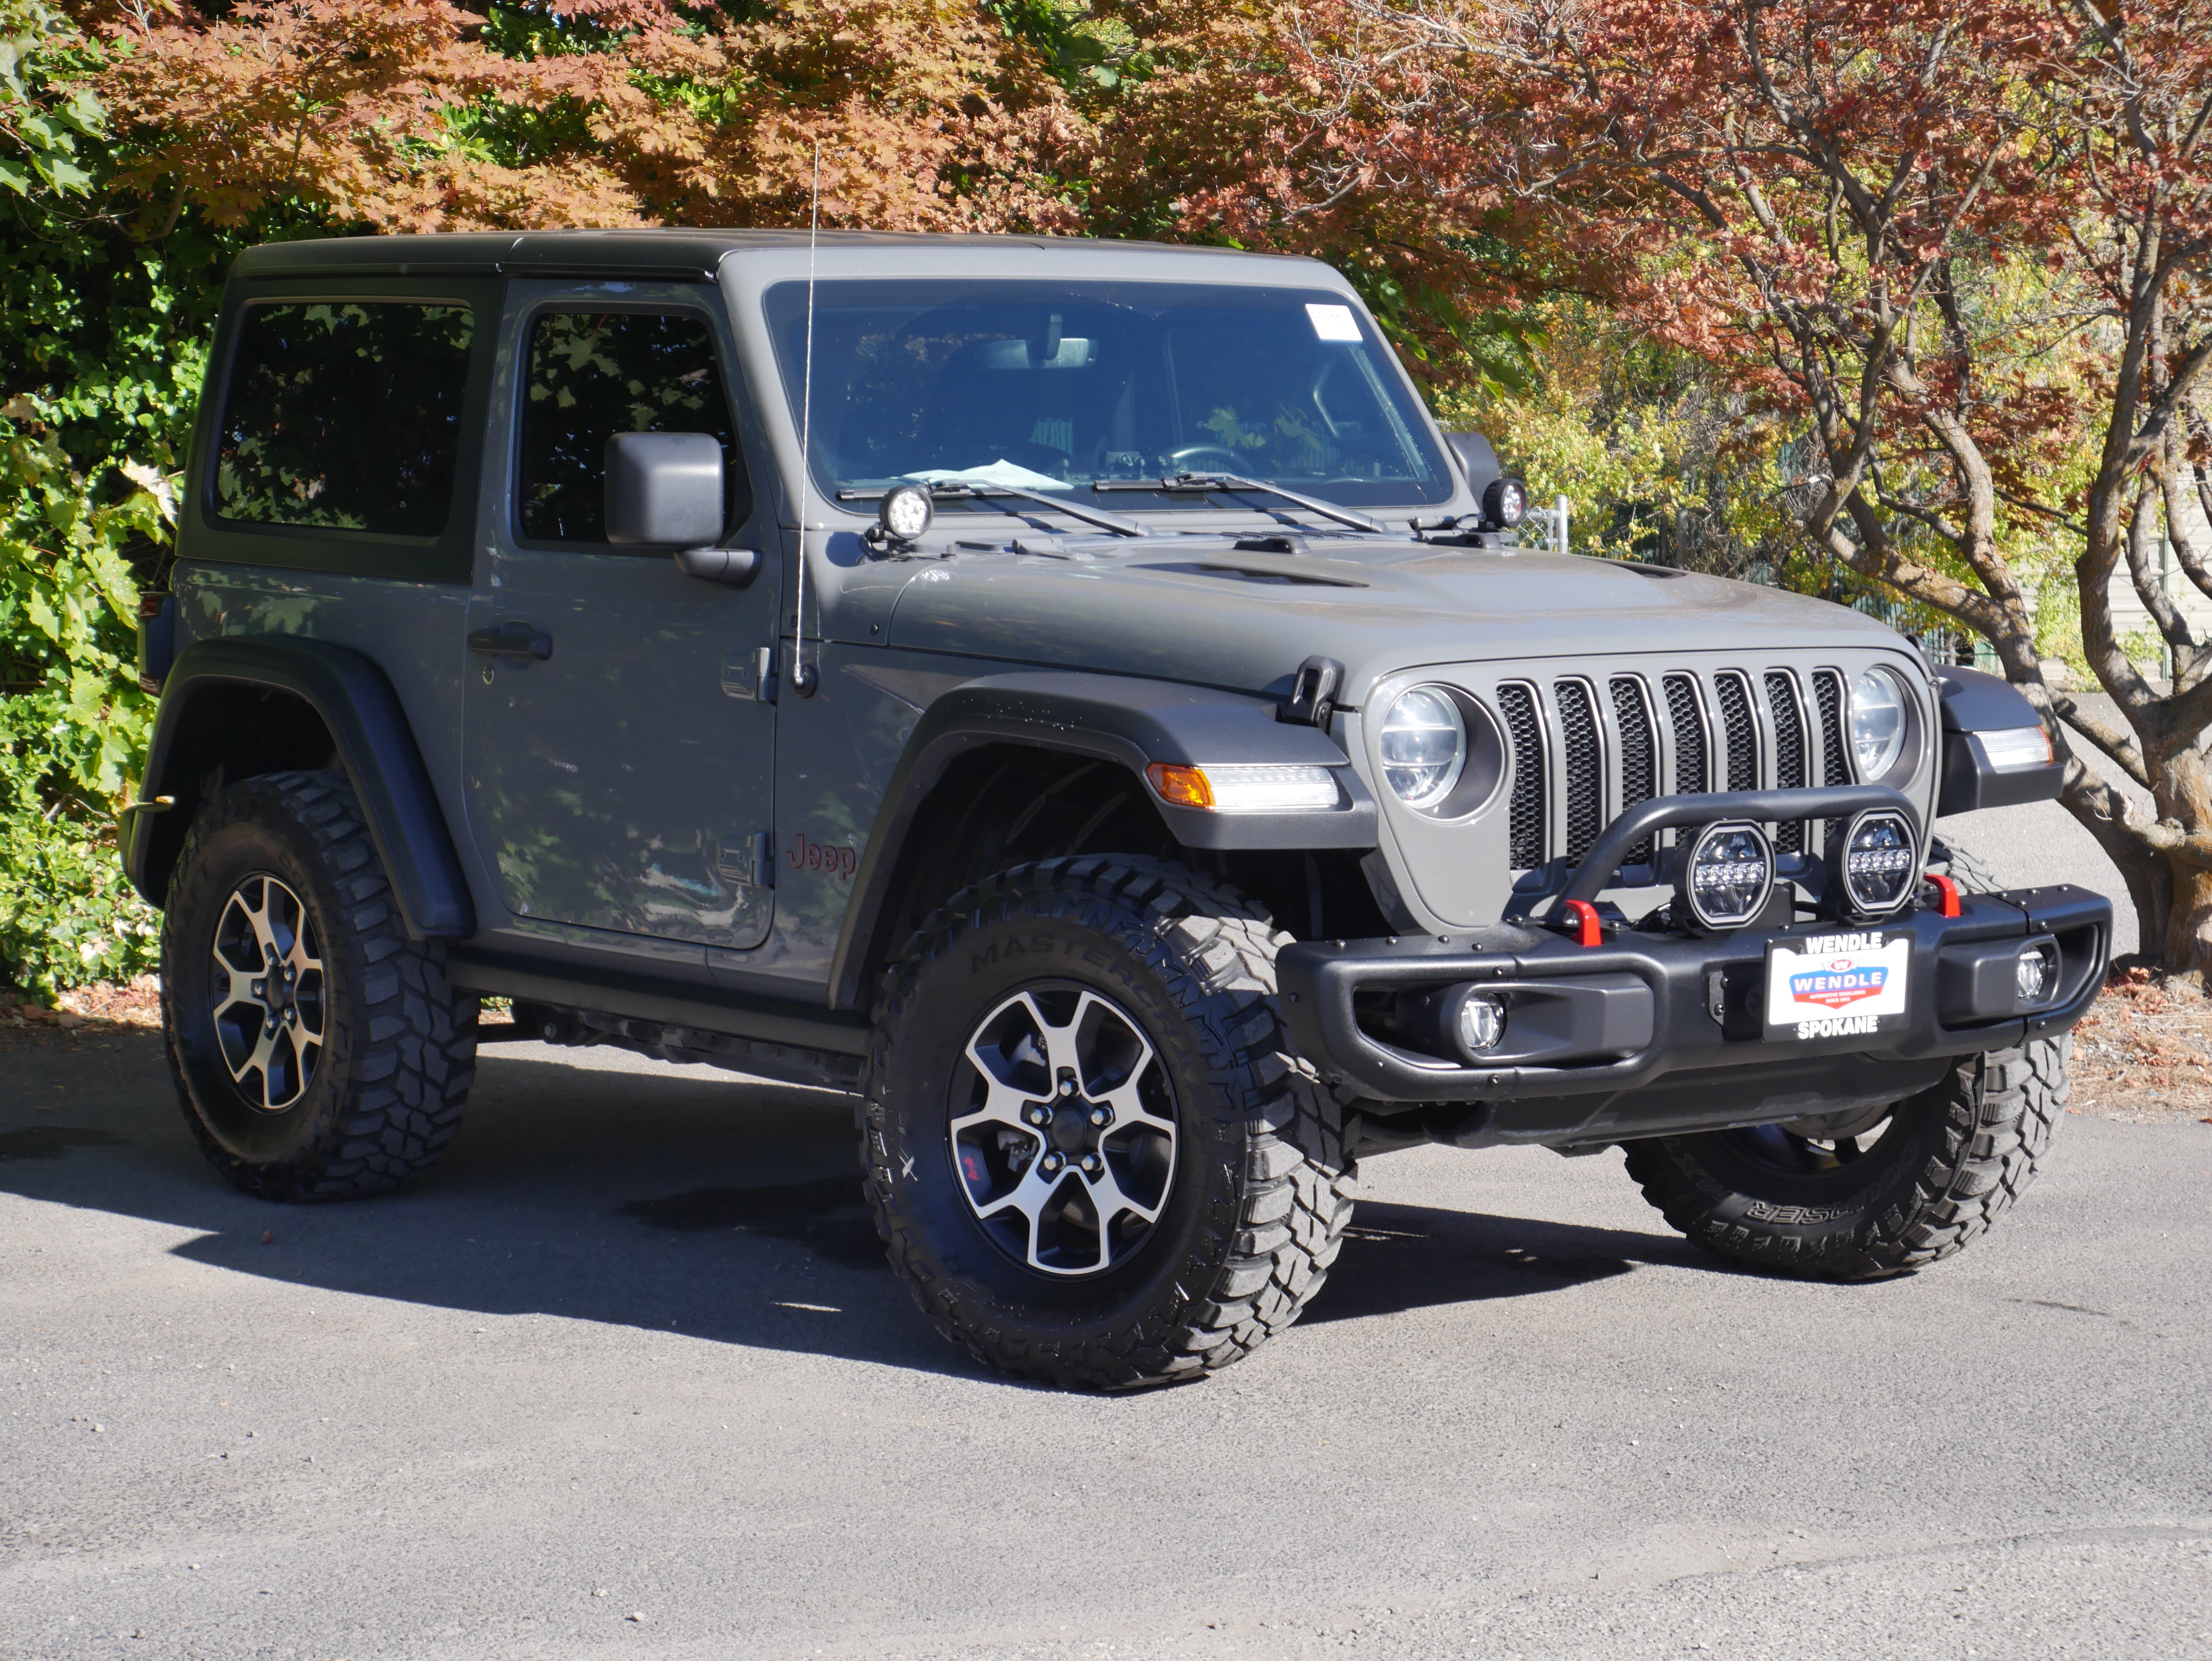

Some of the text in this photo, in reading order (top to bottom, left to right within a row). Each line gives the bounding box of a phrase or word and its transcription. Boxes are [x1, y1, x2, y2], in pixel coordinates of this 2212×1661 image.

[786, 833, 856, 881] Jeep
[1806, 932, 1883, 954] WENDLE
[1834, 961, 1849, 970] W
[1794, 972, 1882, 991] WENDLE
[1798, 1015, 1878, 1039] SPOKANE
[1746, 1138, 1920, 1226] COURSER
